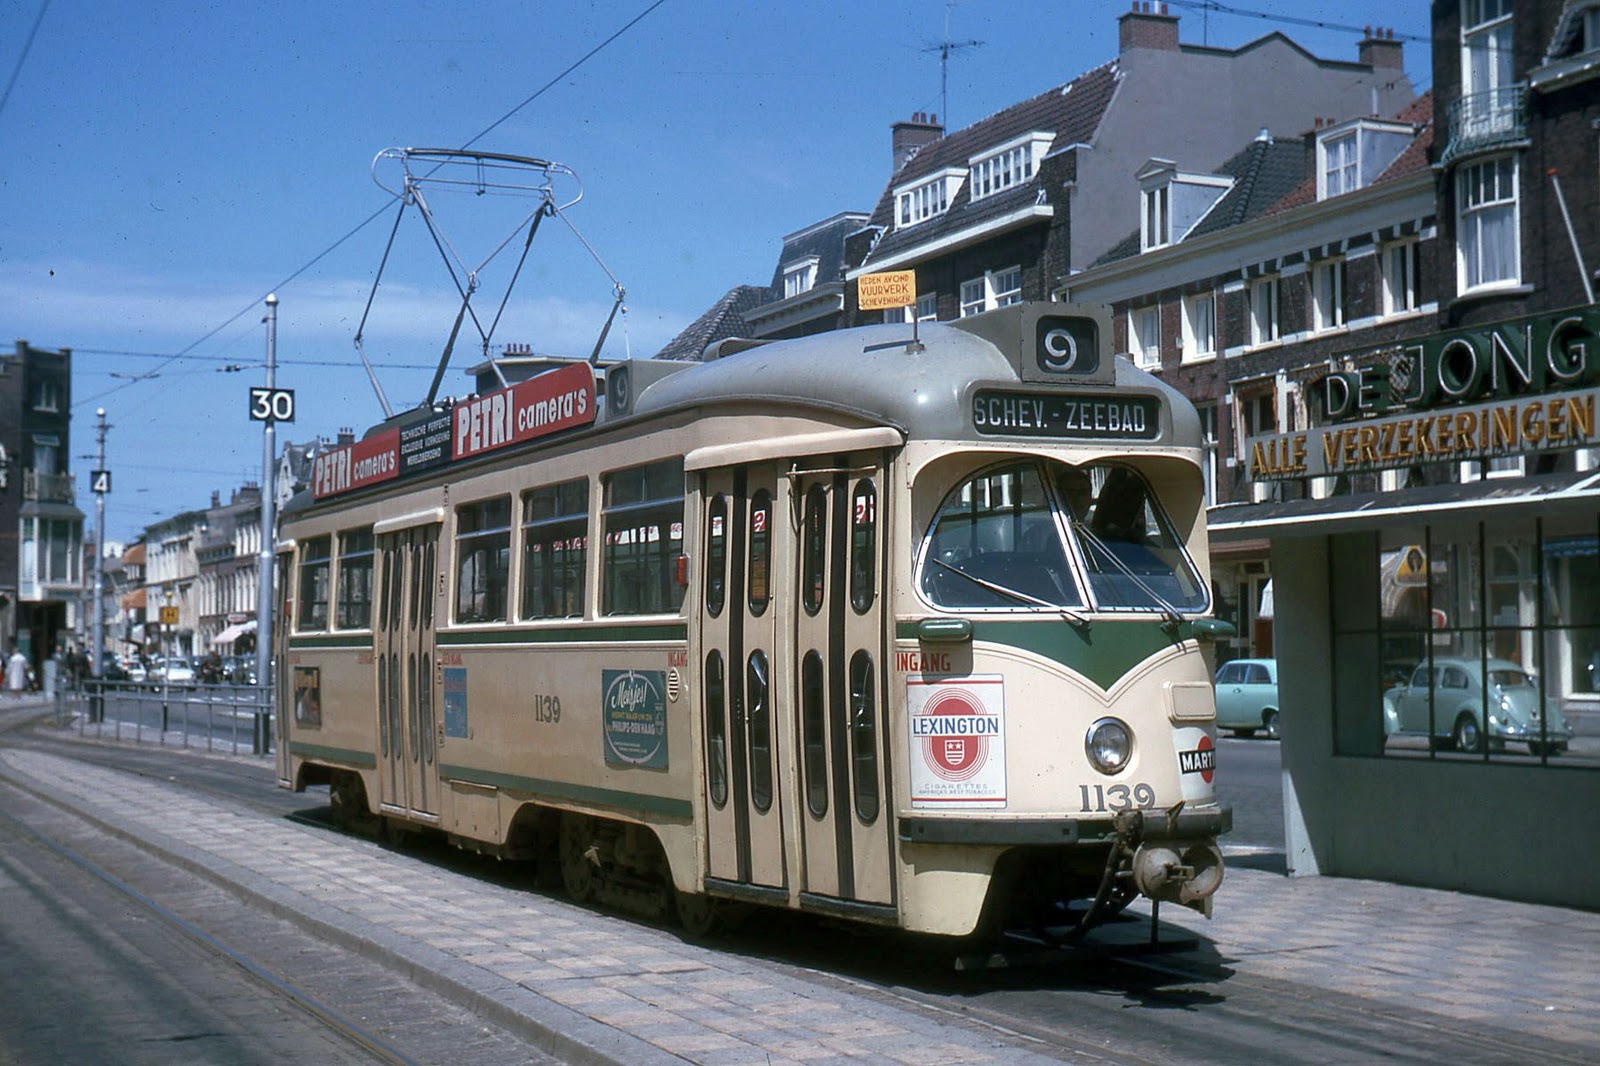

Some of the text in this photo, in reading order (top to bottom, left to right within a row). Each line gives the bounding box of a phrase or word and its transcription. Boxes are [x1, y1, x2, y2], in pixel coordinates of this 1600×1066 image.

[860, 274, 910, 285] HEDEN AVOND
[860, 283, 909, 296] VUURWERK
[860, 295, 911, 307] SCHEVENINGEN
[1044, 328, 1078, 372] 9
[252, 390, 292, 419] 30
[616, 373, 629, 409] 9
[1326, 366, 1376, 416] DE
[457, 388, 588, 456] PETRI camera's
[974, 397, 1048, 428] SCHEV.
[1065, 401, 1146, 433] ZEEBAD
[1251, 394, 1596, 476] ALLE VERZEKERINGEN
[94, 474, 107, 491] 4
[315, 447, 395, 496] PETRI camera's
[668, 651, 688, 667] INGANG
[896, 653, 951, 672] INGANG
[534, 694, 561, 723] 1139
[611, 680, 648, 712] Meisjes!
[912, 717, 999, 735] LEXINGTON
[1079, 783, 1156, 812] 1139
